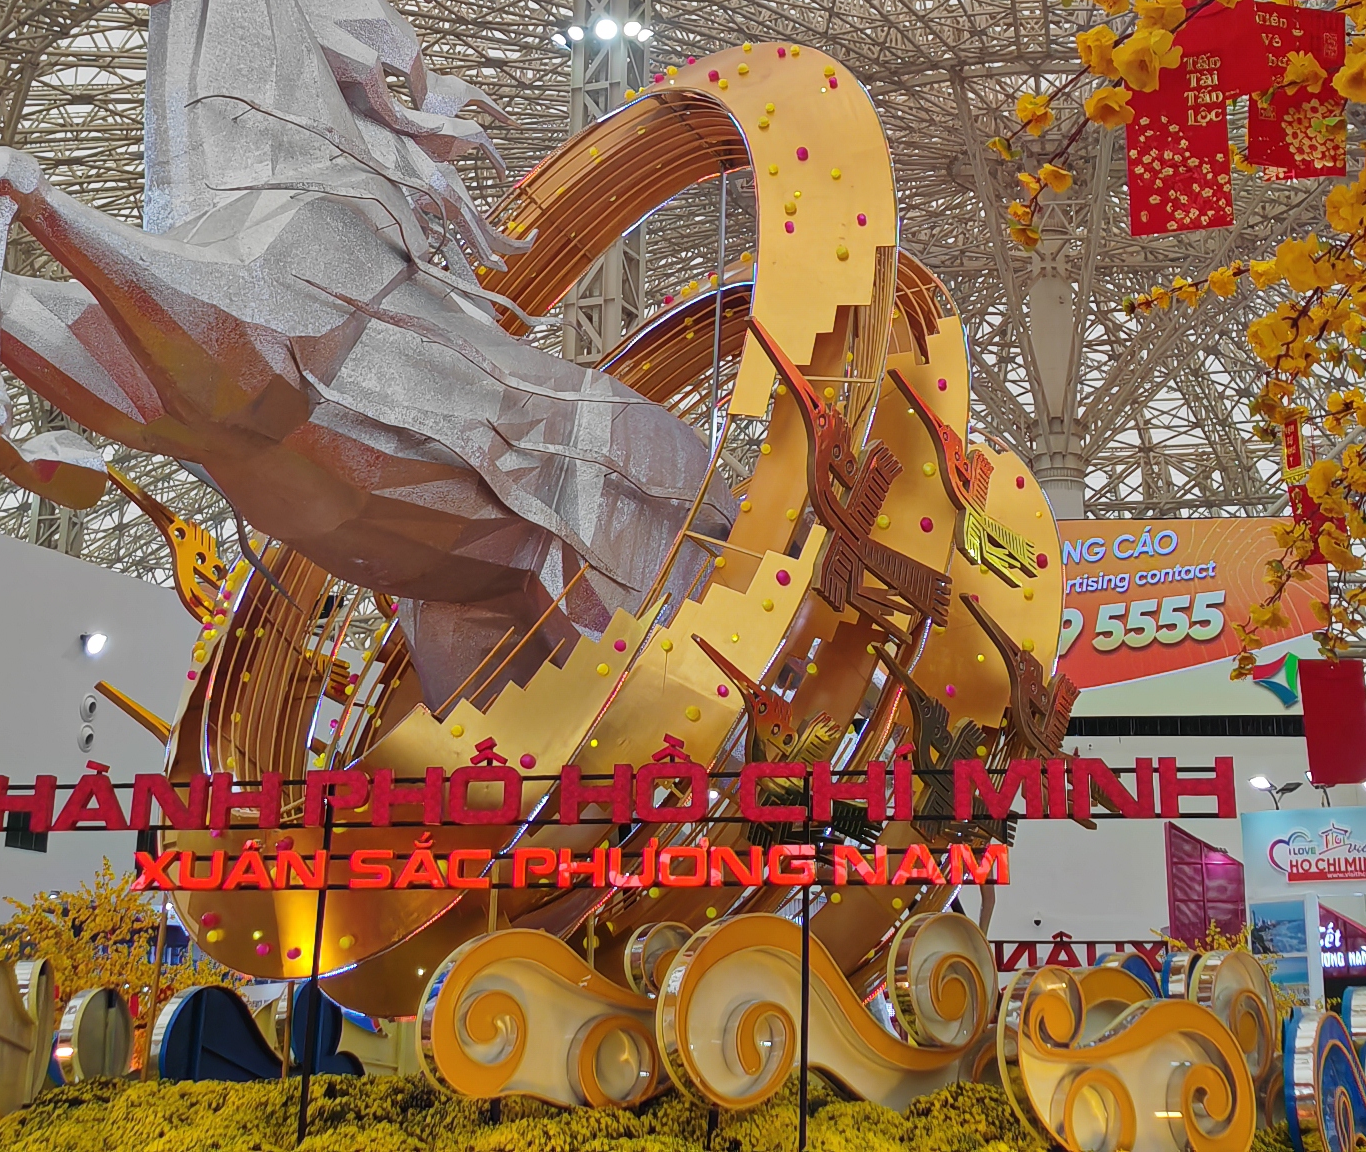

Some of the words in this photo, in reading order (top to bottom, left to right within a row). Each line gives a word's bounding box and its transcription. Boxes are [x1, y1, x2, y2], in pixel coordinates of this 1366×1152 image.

[1186, 71, 1219, 88] Tài
[1187, 107, 1223, 127] Lộc
[1112, 526, 1178, 559] CÁO
[1135, 559, 1217, 586] contact
[1092, 589, 1226, 652] 5555
[303, 736, 523, 828] PHỐ
[559, 732, 710, 825] HỒ
[739, 742, 917, 823] CHÍ
[953, 756, 1238, 821] MINH
[129, 831, 328, 890] XUÂN
[349, 830, 493, 889] SẮC
[512, 837, 816, 888] PHƯƠNG
[833, 843, 1010, 887] NAM
[1293, 846, 1317, 856] LOVE
[1289, 858, 1313, 874] HO
[1315, 857, 1342, 872] CHI
